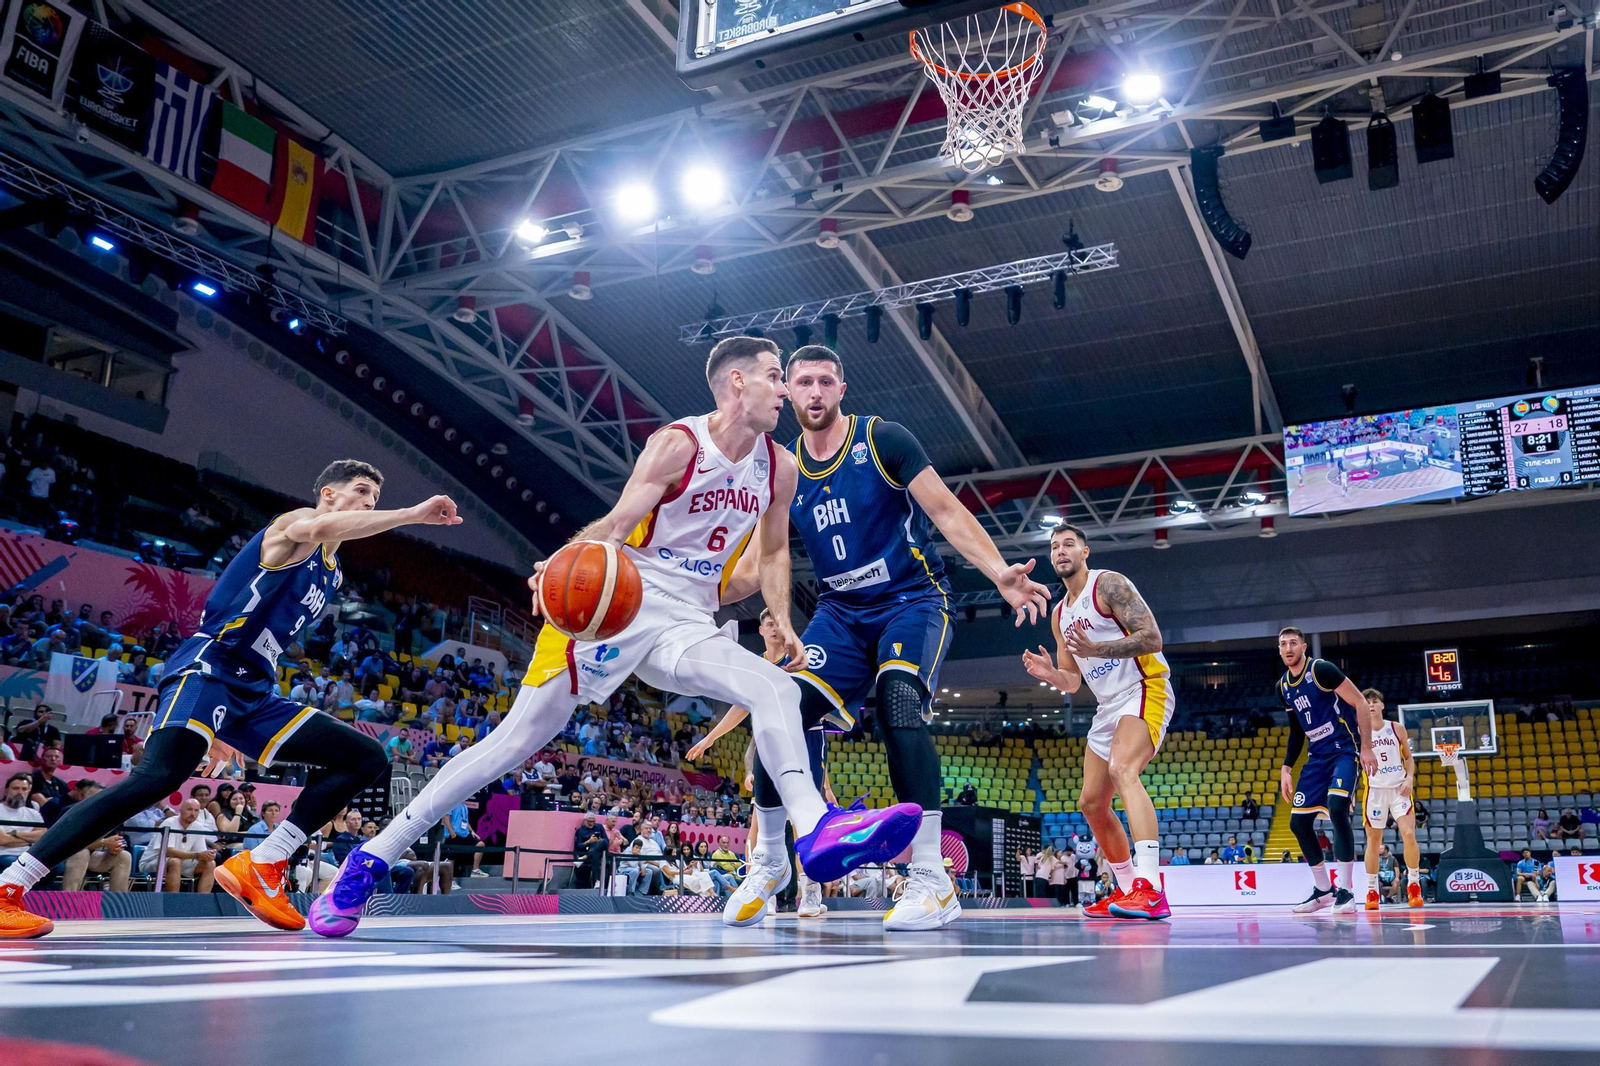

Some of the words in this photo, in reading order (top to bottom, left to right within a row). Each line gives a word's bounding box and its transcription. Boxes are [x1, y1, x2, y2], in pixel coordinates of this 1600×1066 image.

[15, 45, 49, 75] FIBA
[80, 96, 138, 128] EUROBASKET
[1514, 423, 1528, 433] 27
[1549, 418, 1563, 428] 18
[1528, 433, 1552, 445] 8:21
[1520, 478, 1527, 486] 0
[1535, 475, 1555, 483] FOULS
[1563, 473, 1570, 481] 0
[688, 486, 760, 515] ESPAÑA
[813, 498, 851, 533] BIH
[707, 526, 728, 552] 6
[832, 534, 847, 561] 0
[300, 583, 326, 619] BIH
[289, 615, 305, 636] 9
[1433, 652, 1456, 664] 8:20
[1430, 665, 1452, 681] 4.6
[1294, 694, 1312, 712] BIH
[1371, 737, 1396, 749] SPAÑA
[1380, 751, 1388, 762] 5
[1378, 764, 1403, 774] ndesa
